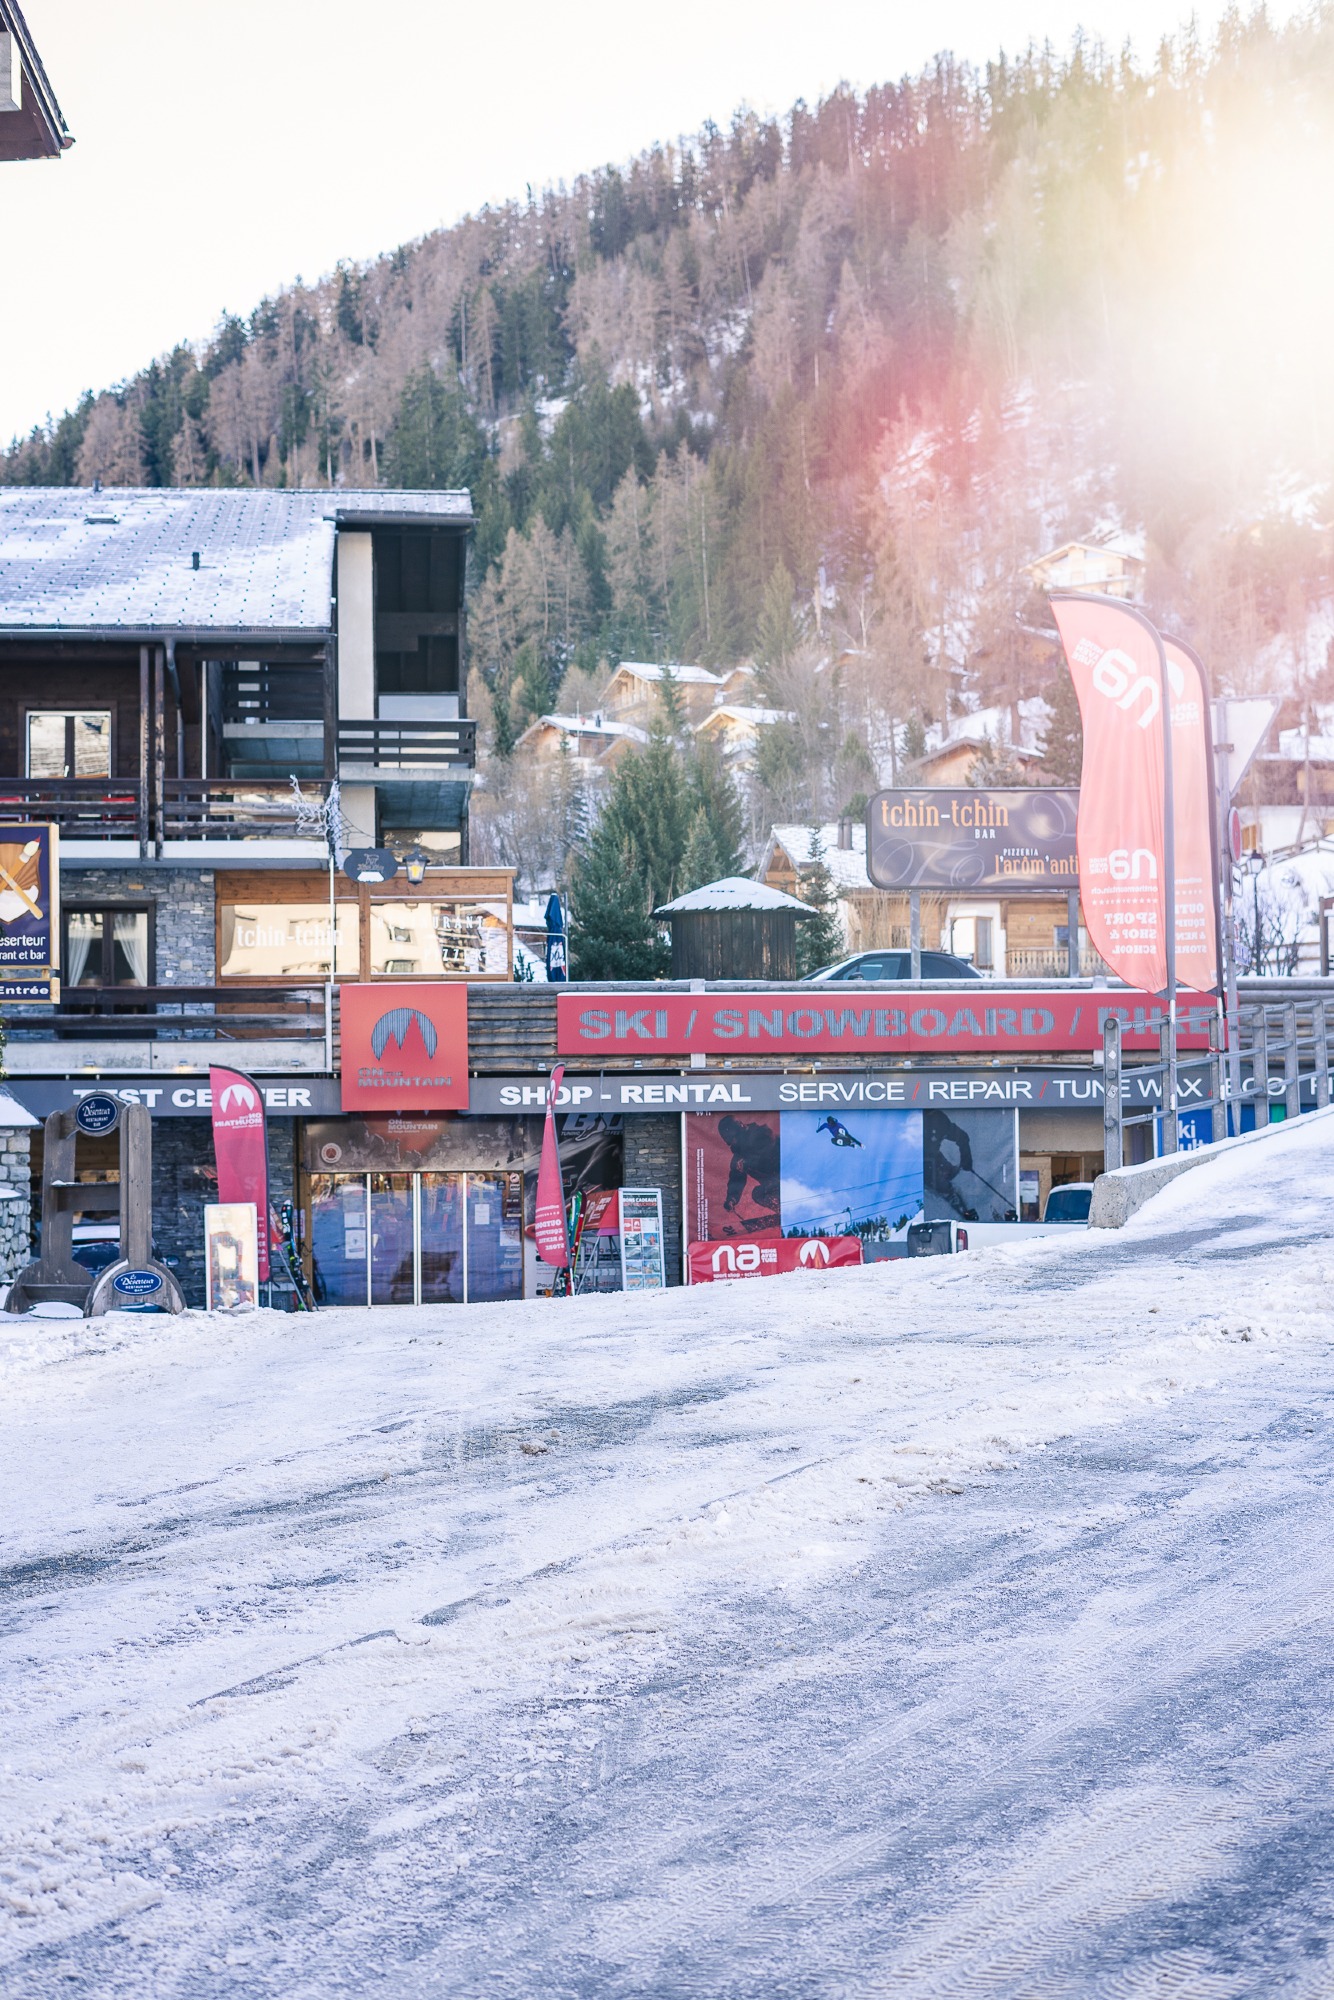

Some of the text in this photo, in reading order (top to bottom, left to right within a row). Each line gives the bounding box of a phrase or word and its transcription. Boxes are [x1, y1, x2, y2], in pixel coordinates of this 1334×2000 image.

[881, 799, 1009, 827] tchin-tchin
[975, 829, 996, 839] BAR
[1003, 848, 1039, 857] PIZZERIA
[237, 924, 344, 947] tchin-tchin
[19, 950, 28, 960] et
[30, 949, 46, 960] bar
[0, 985, 49, 995] Entrée
[579, 1009, 668, 1039] SKI
[712, 1008, 1055, 1038] SNOWBOARD
[1097, 1006, 1217, 1035] BIKE
[358, 1068, 384, 1077] ON
[358, 1076, 452, 1087] MOUNTAIN
[171, 1087, 312, 1107] CEER
[500, 1085, 593, 1106] SHOP
[620, 1084, 751, 1104] RENTAL
[779, 1081, 905, 1102] SERVICE
[929, 1080, 1033, 1100] REPAIR
[711, 1243, 761, 1272] na
